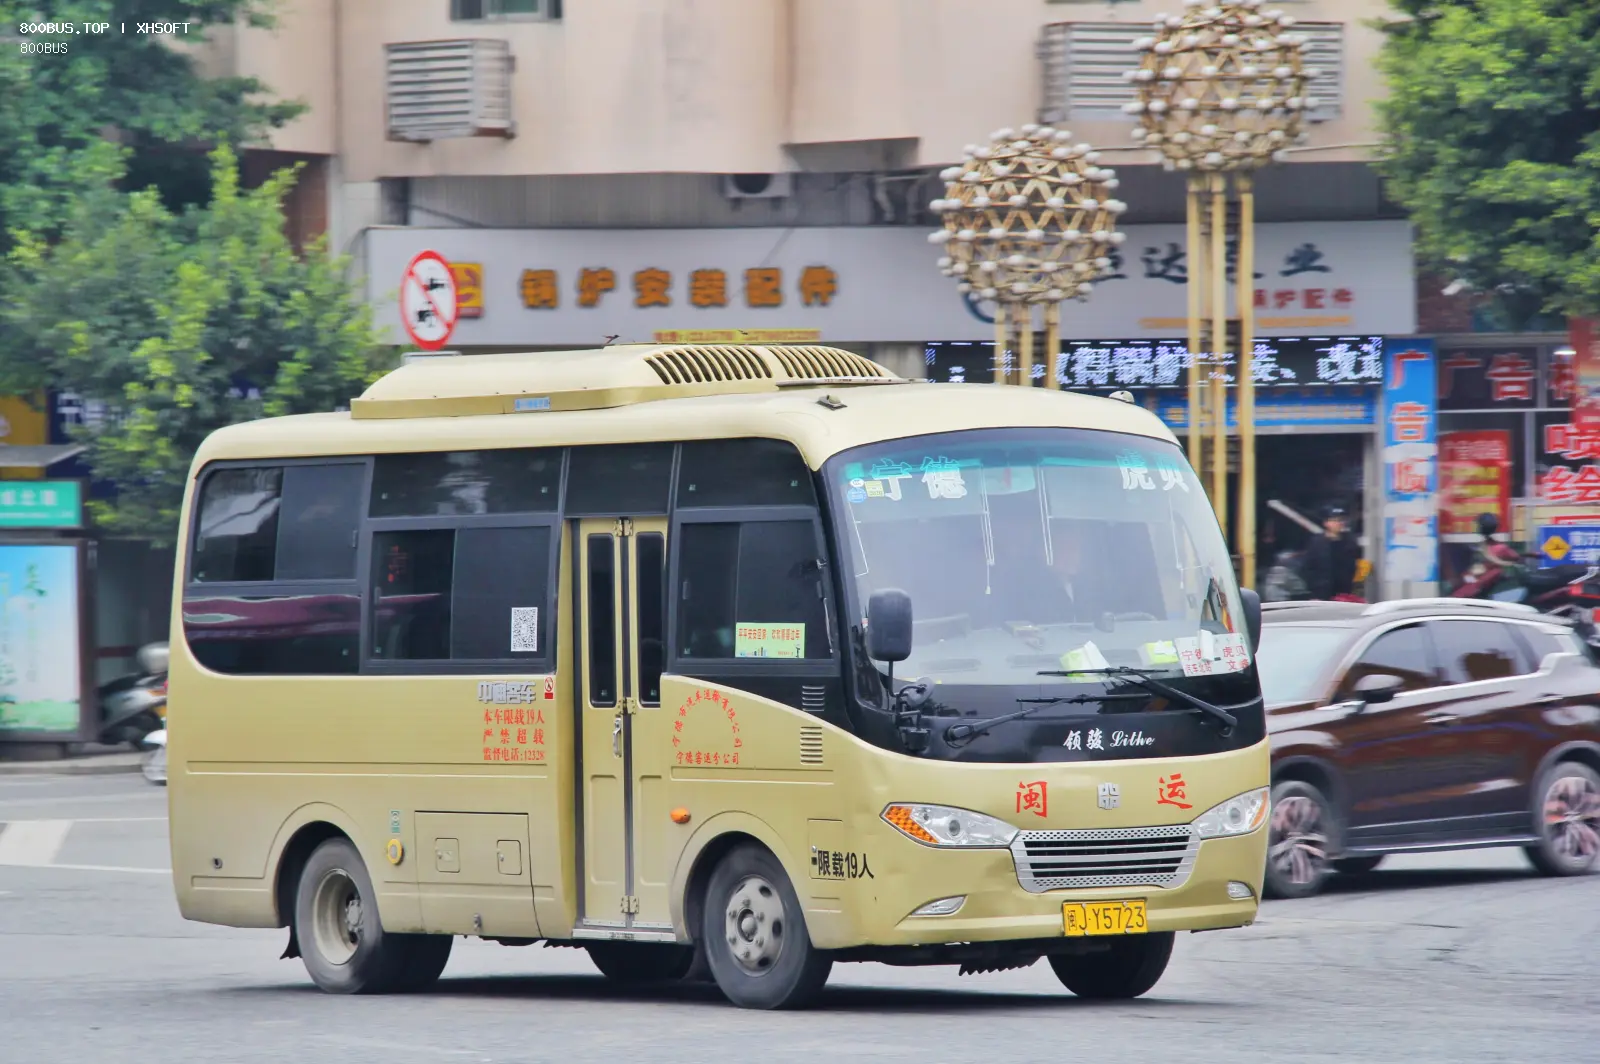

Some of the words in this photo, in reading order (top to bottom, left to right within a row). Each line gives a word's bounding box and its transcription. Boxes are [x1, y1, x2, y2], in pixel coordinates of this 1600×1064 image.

[520, 266, 839, 309] 锅炉安装配件
[869, 456, 968, 501] 宁德
[1115, 448, 1190, 494] 虎贝
[478, 681, 537, 704] 中通客车
[483, 708, 546, 726] 本车限载19人
[482, 728, 546, 745] 严禁超载
[1063, 727, 1105, 751] 领骏
[1109, 729, 1155, 748] Lithe
[1016, 781, 1048, 818] 闽
[1156, 773, 1193, 810] 运
[817, 850, 875, 880] 限载19人
